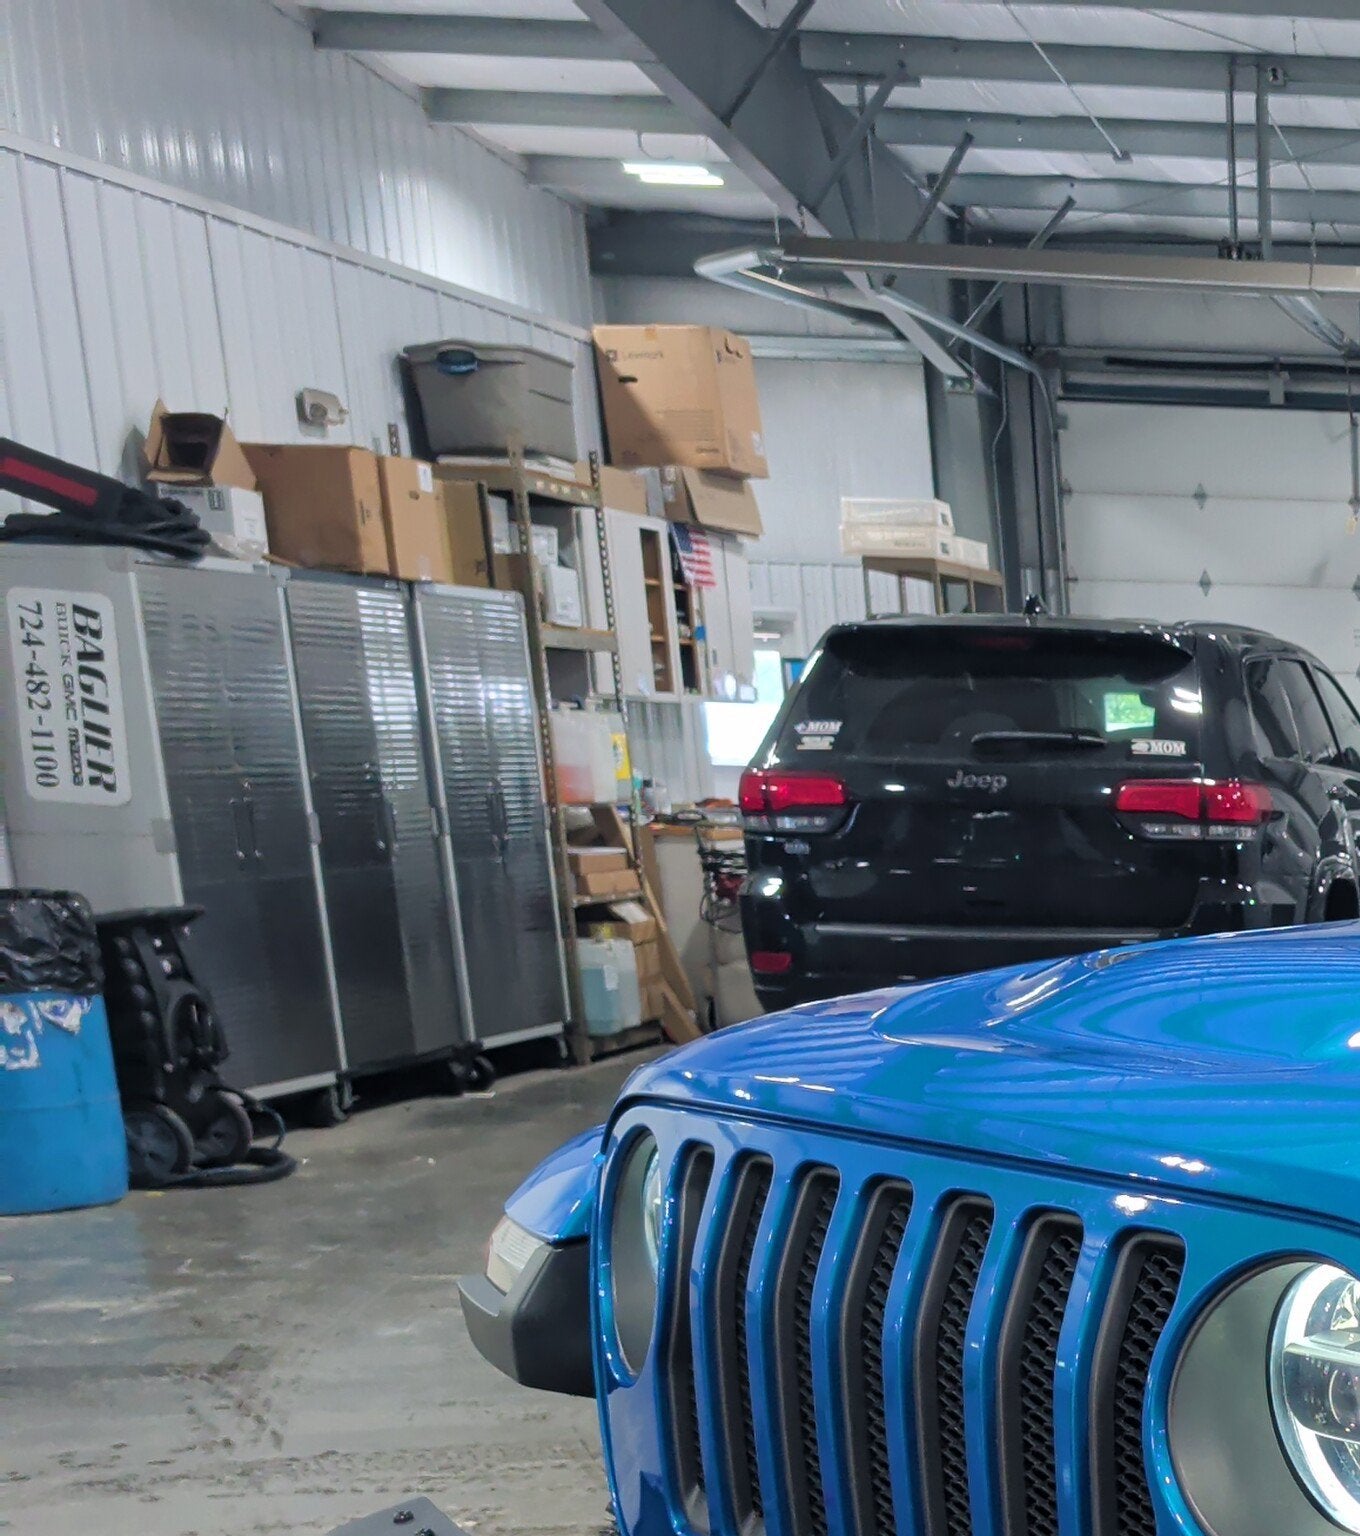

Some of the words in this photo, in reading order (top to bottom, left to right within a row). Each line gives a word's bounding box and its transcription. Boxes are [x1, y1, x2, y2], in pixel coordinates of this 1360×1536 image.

[18, 600, 60, 788] 724-482-1100
[62, 674, 77, 721] GMC
[72, 603, 117, 793] BAGLIER
[1150, 741, 1186, 755] MOM
[946, 769, 1008, 794] Jeep
